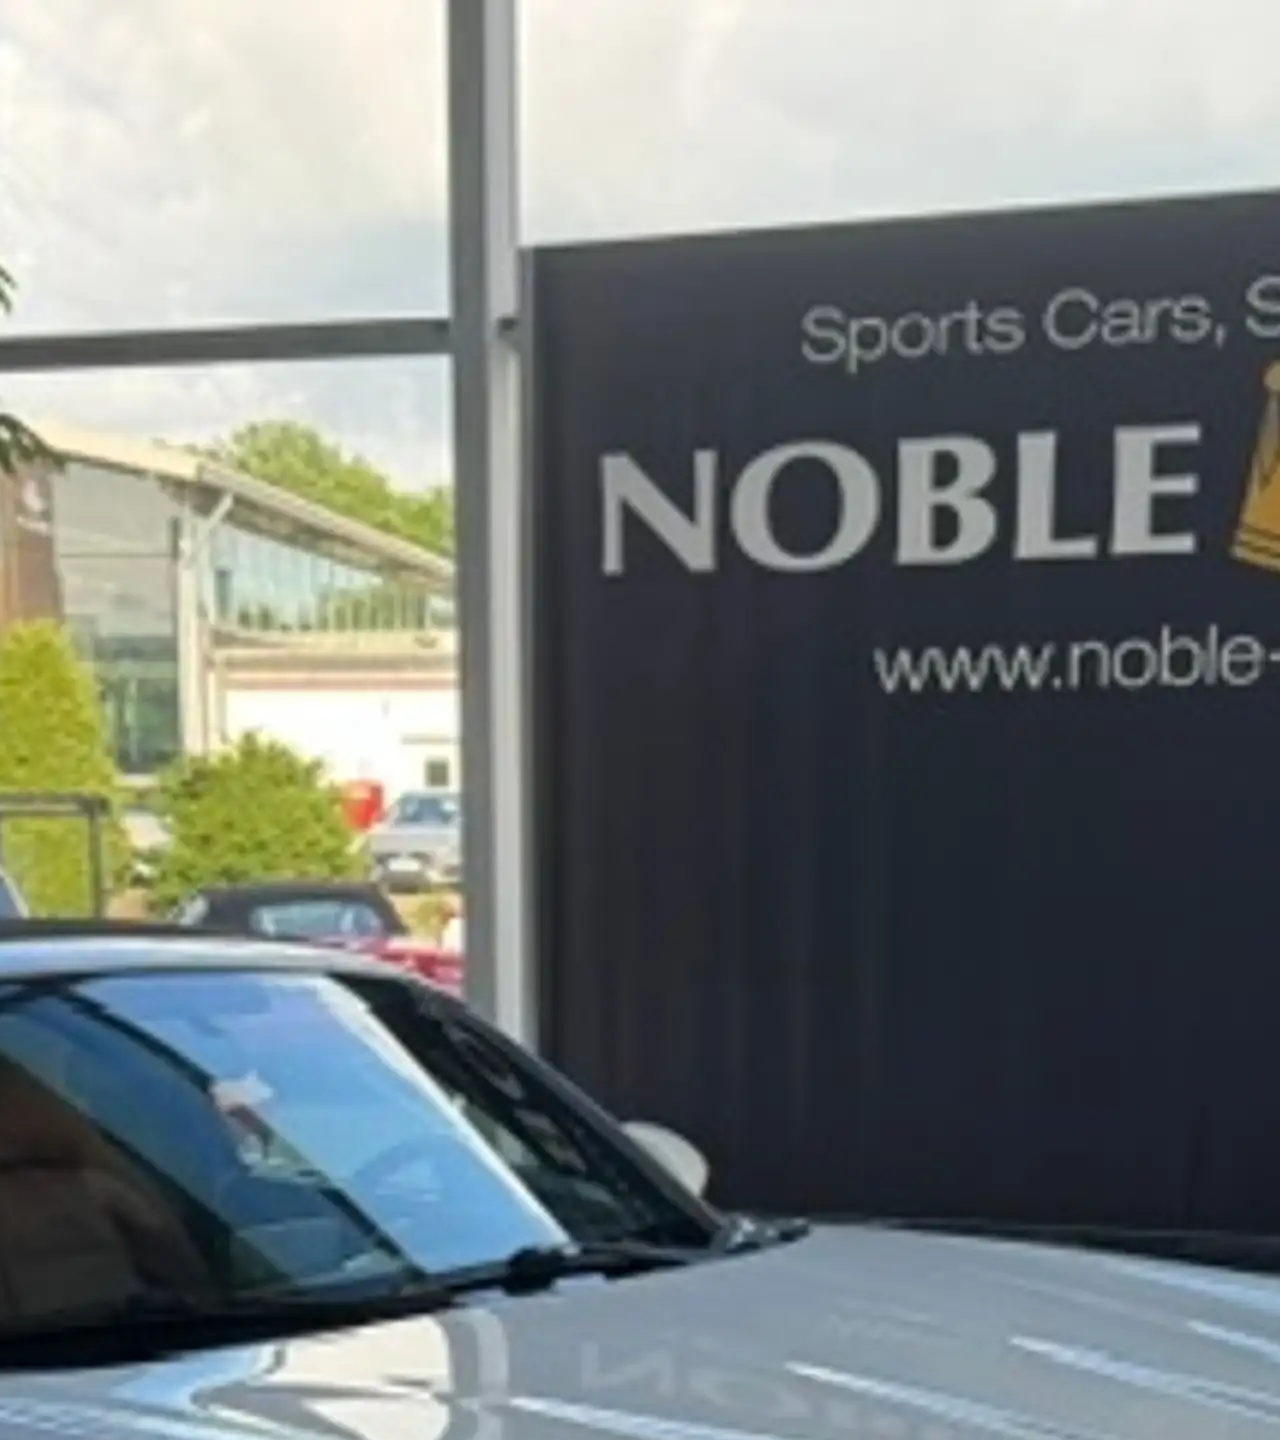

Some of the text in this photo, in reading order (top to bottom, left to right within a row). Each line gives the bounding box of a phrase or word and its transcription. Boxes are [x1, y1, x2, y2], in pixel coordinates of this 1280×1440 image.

[801, 301, 1026, 374] Sports
[1042, 287, 1225, 348] Cars,
[599, 421, 1201, 575] NOBLE
